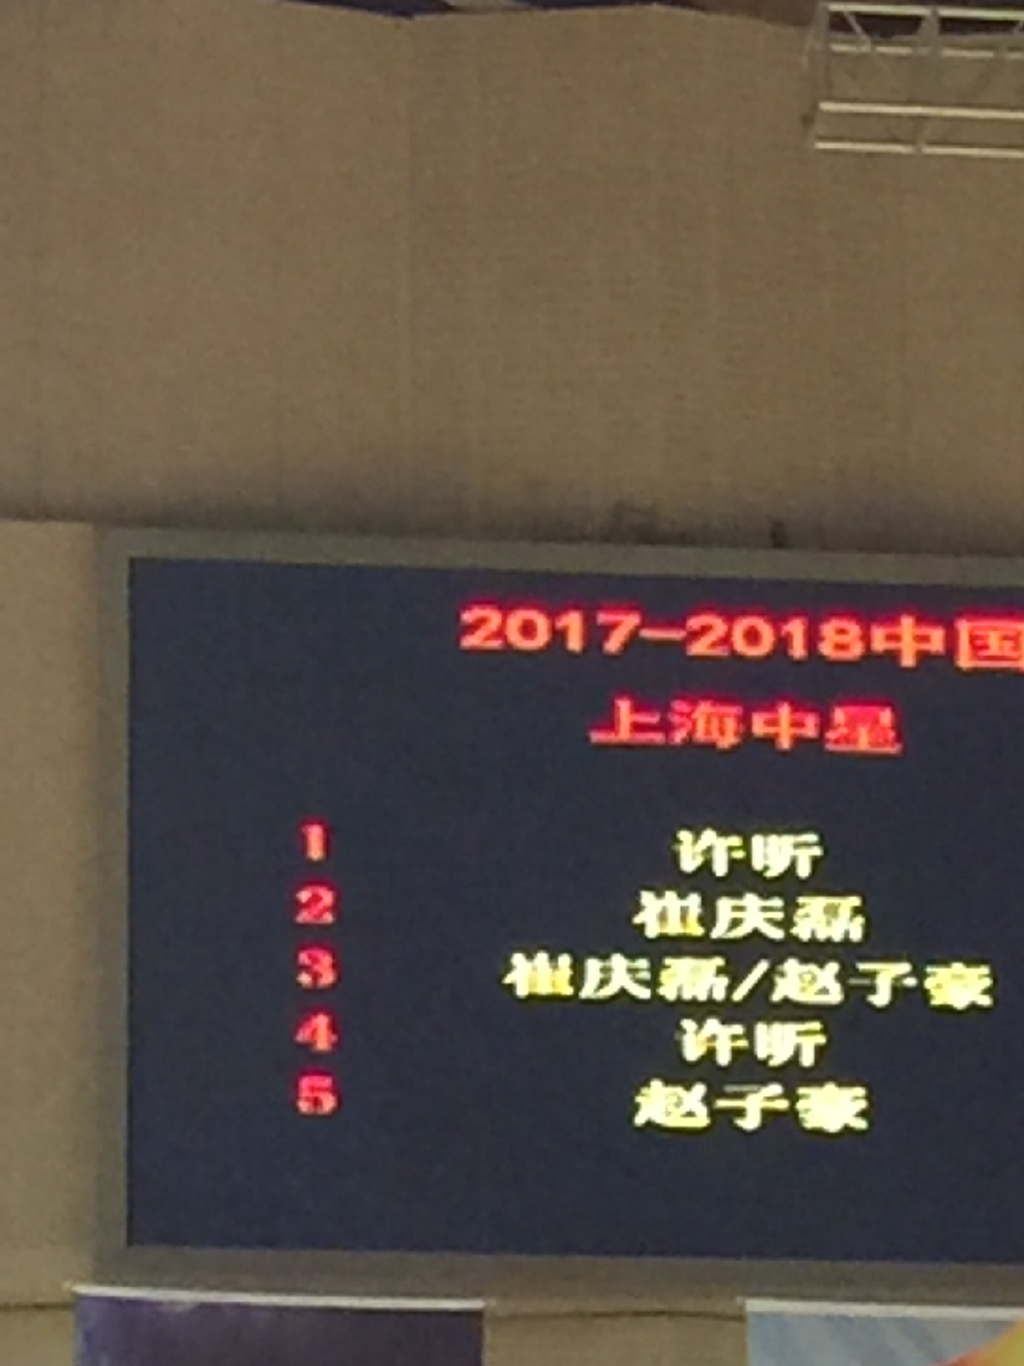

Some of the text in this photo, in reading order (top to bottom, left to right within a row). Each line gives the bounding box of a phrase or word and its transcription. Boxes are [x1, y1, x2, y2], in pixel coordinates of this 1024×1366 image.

[589, 696, 904, 756] 上海中星
[301, 822, 329, 863] 1
[296, 884, 337, 926] 2
[633, 891, 867, 943] 崔庆磊
[297, 946, 338, 989] 3
[296, 1012, 339, 1053] 4
[297, 1073, 339, 1116] 5
[633, 1079, 871, 1134] 赵子豪
